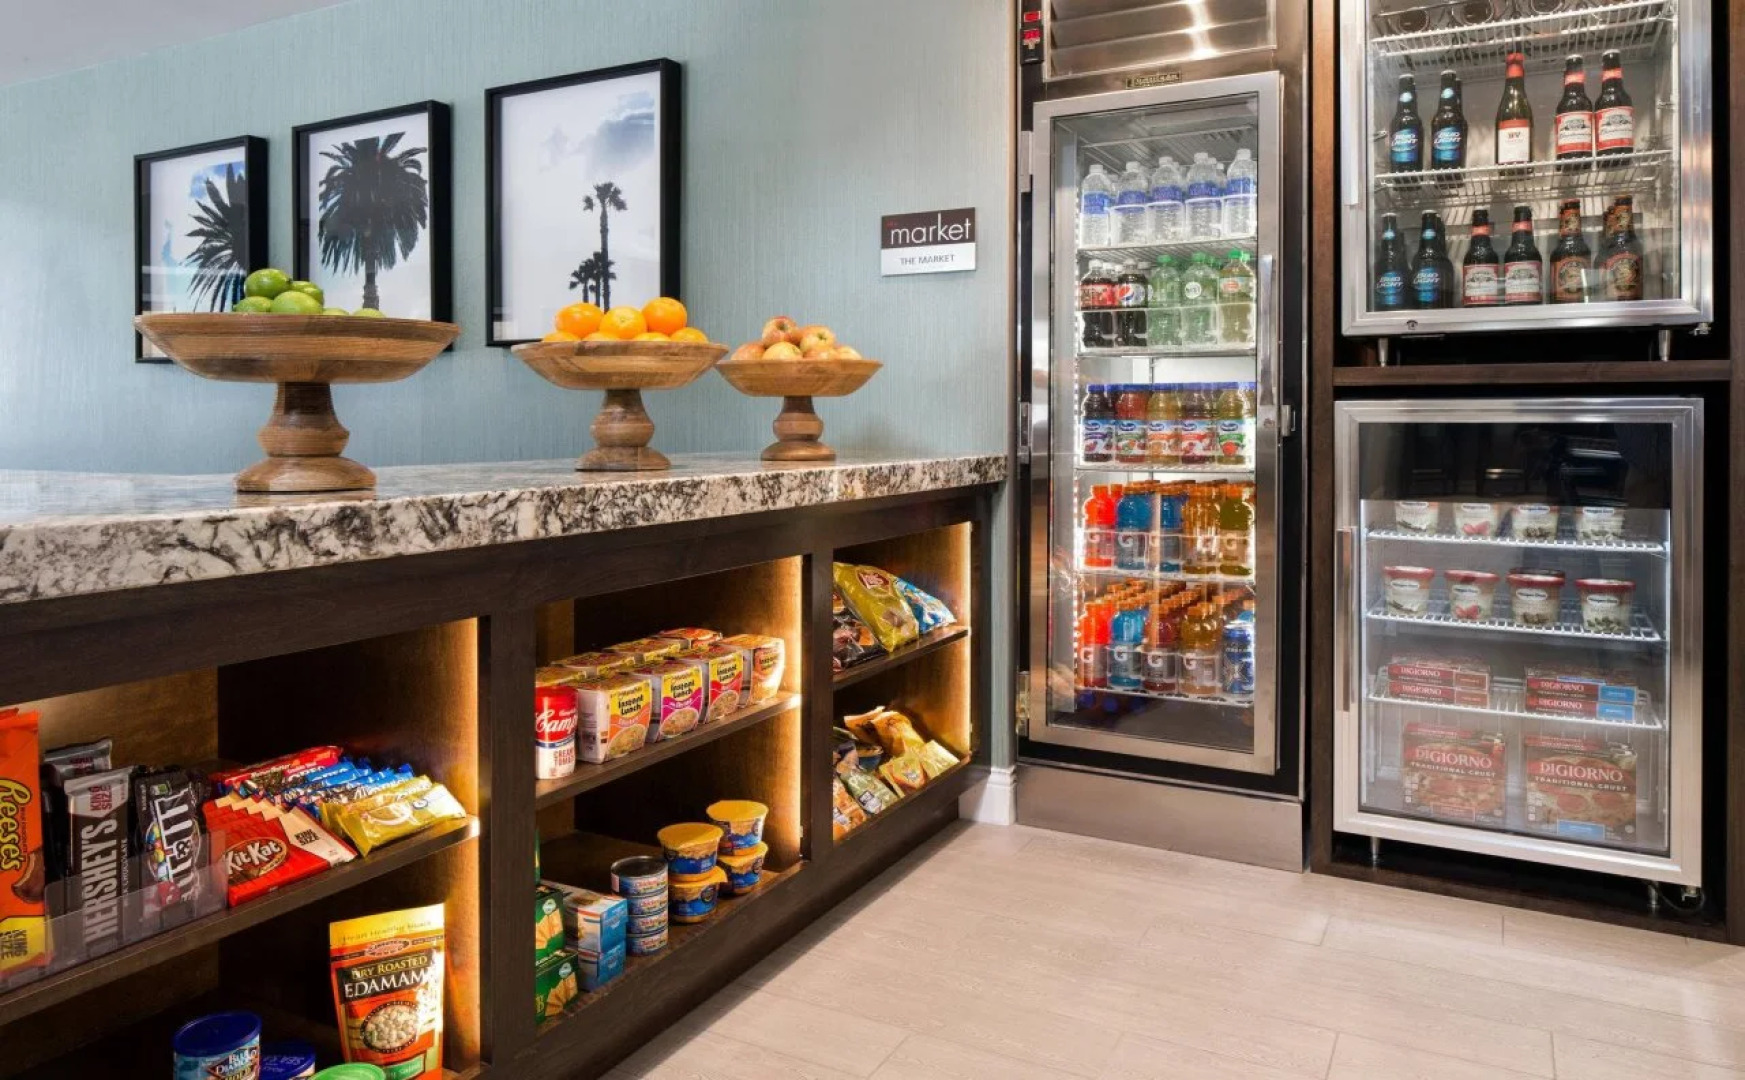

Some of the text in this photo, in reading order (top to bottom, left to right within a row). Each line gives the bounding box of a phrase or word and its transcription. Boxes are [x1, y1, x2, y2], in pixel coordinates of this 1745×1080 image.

[890, 212, 972, 245] market
[900, 254, 954, 265] THE MARKET
[1117, 532, 1134, 548] G
[1080, 648, 1095, 663] G
[1113, 647, 1128, 661] G
[1147, 652, 1164, 667] G
[1183, 653, 1197, 669] G
[617, 694, 645, 710] Instant
[620, 703, 642, 716] Lunch
[1415, 748, 1493, 770] DIGIORNO
[1540, 761, 1623, 782] DIGIORNO
[1534, 775, 1628, 792] TRADITIONAL CRUST
[90, 786, 101, 811] KING
[101, 785, 113, 811] SIZE
[82, 818, 119, 942] HERSHEY'S
[378, 955, 428, 975] ROASTED
[344, 969, 433, 999] EDAMAM
